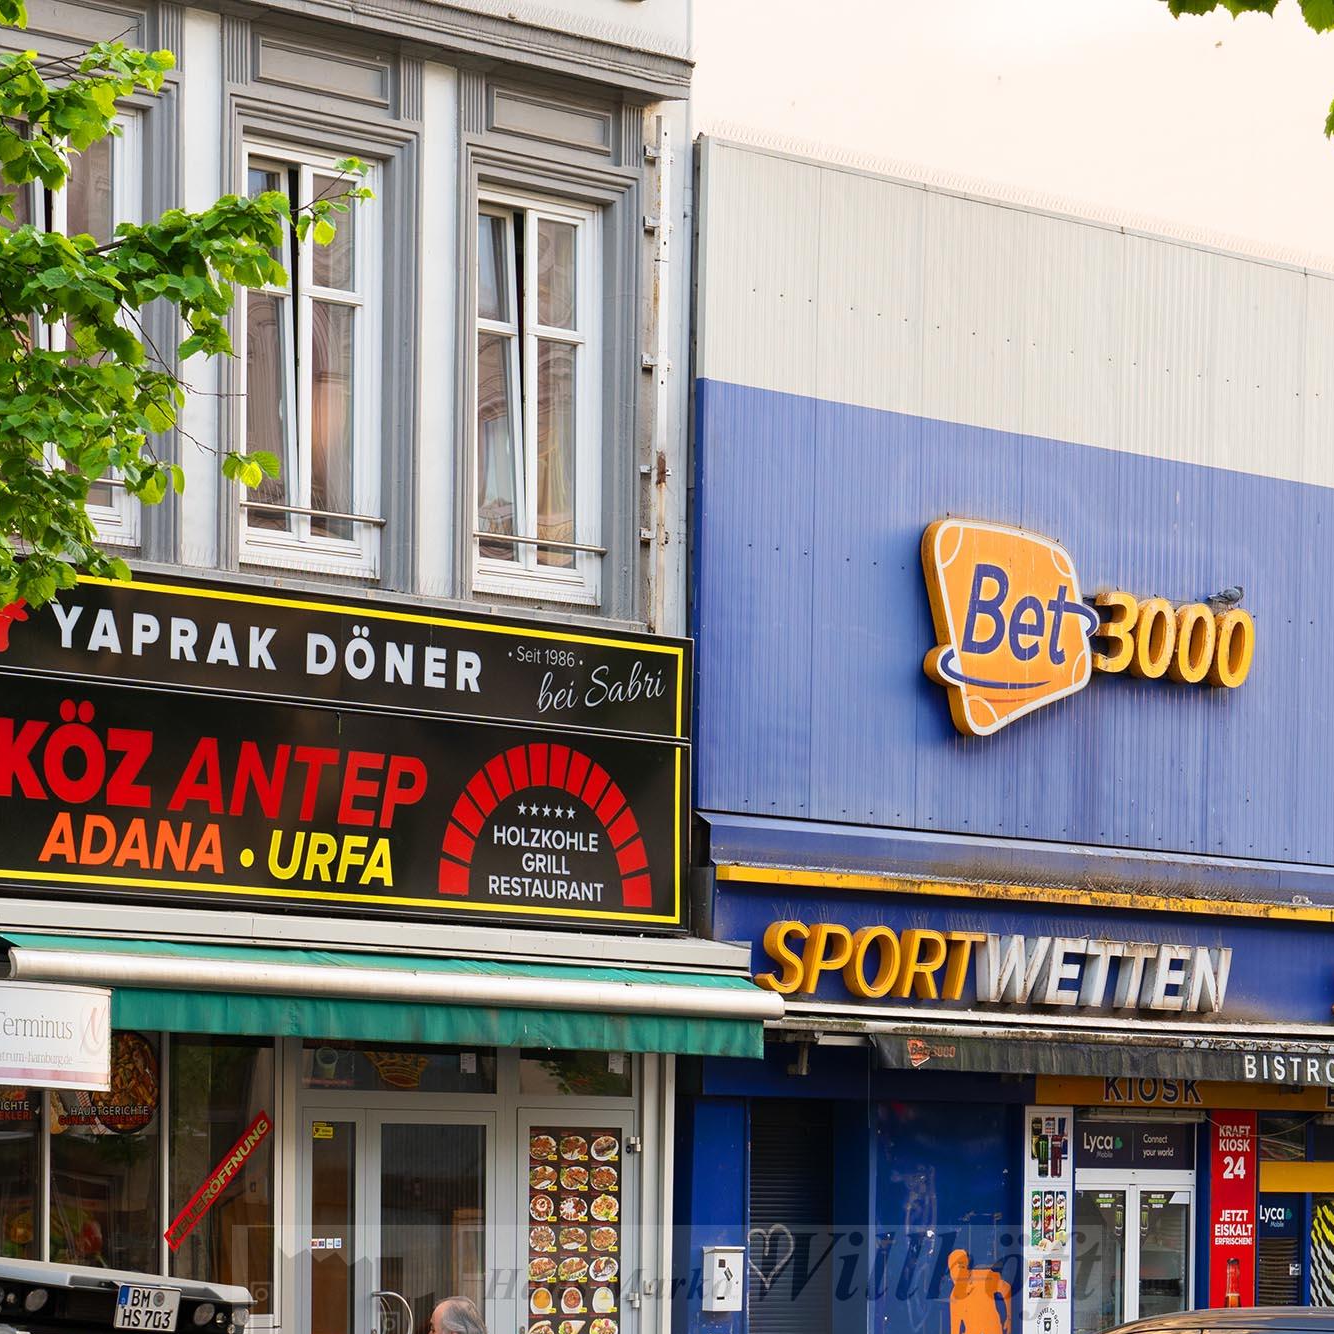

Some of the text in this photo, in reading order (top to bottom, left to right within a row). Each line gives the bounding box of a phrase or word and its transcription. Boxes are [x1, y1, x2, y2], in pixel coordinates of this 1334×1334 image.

[961, 563, 1255, 688] Bet 3000
[51, 604, 482, 693] YAPRAK DÖNER
[517, 645, 575, 668] Seit 1986
[536, 660, 666, 713] bei Sabri
[168, 737, 428, 829] ANTEP
[38, 812, 394, 887] ADANA URFA
[493, 825, 599, 853] HOLZKOHLE
[522, 853, 571, 875] GRILL
[488, 875, 604, 902] RESTAURANT
[1103, 1077, 1203, 1104] KIOSK
[1083, 1132, 1168, 1153] Lyca Connect
[1219, 1125, 1251, 1137] KRAFT
[1219, 1139, 1251, 1152] KIOSK
[1223, 1156, 1246, 1179] 24
[170, 1119, 269, 1246] NEUERÖFFNUNG
[1219, 1210, 1248, 1222] JETZT
[1259, 1204, 1285, 1223] Lyca
[1214, 1224, 1253, 1237] EISKALT
[131, 1290, 151, 1308] BM
[122, 1309, 171, 1329] HS 703
